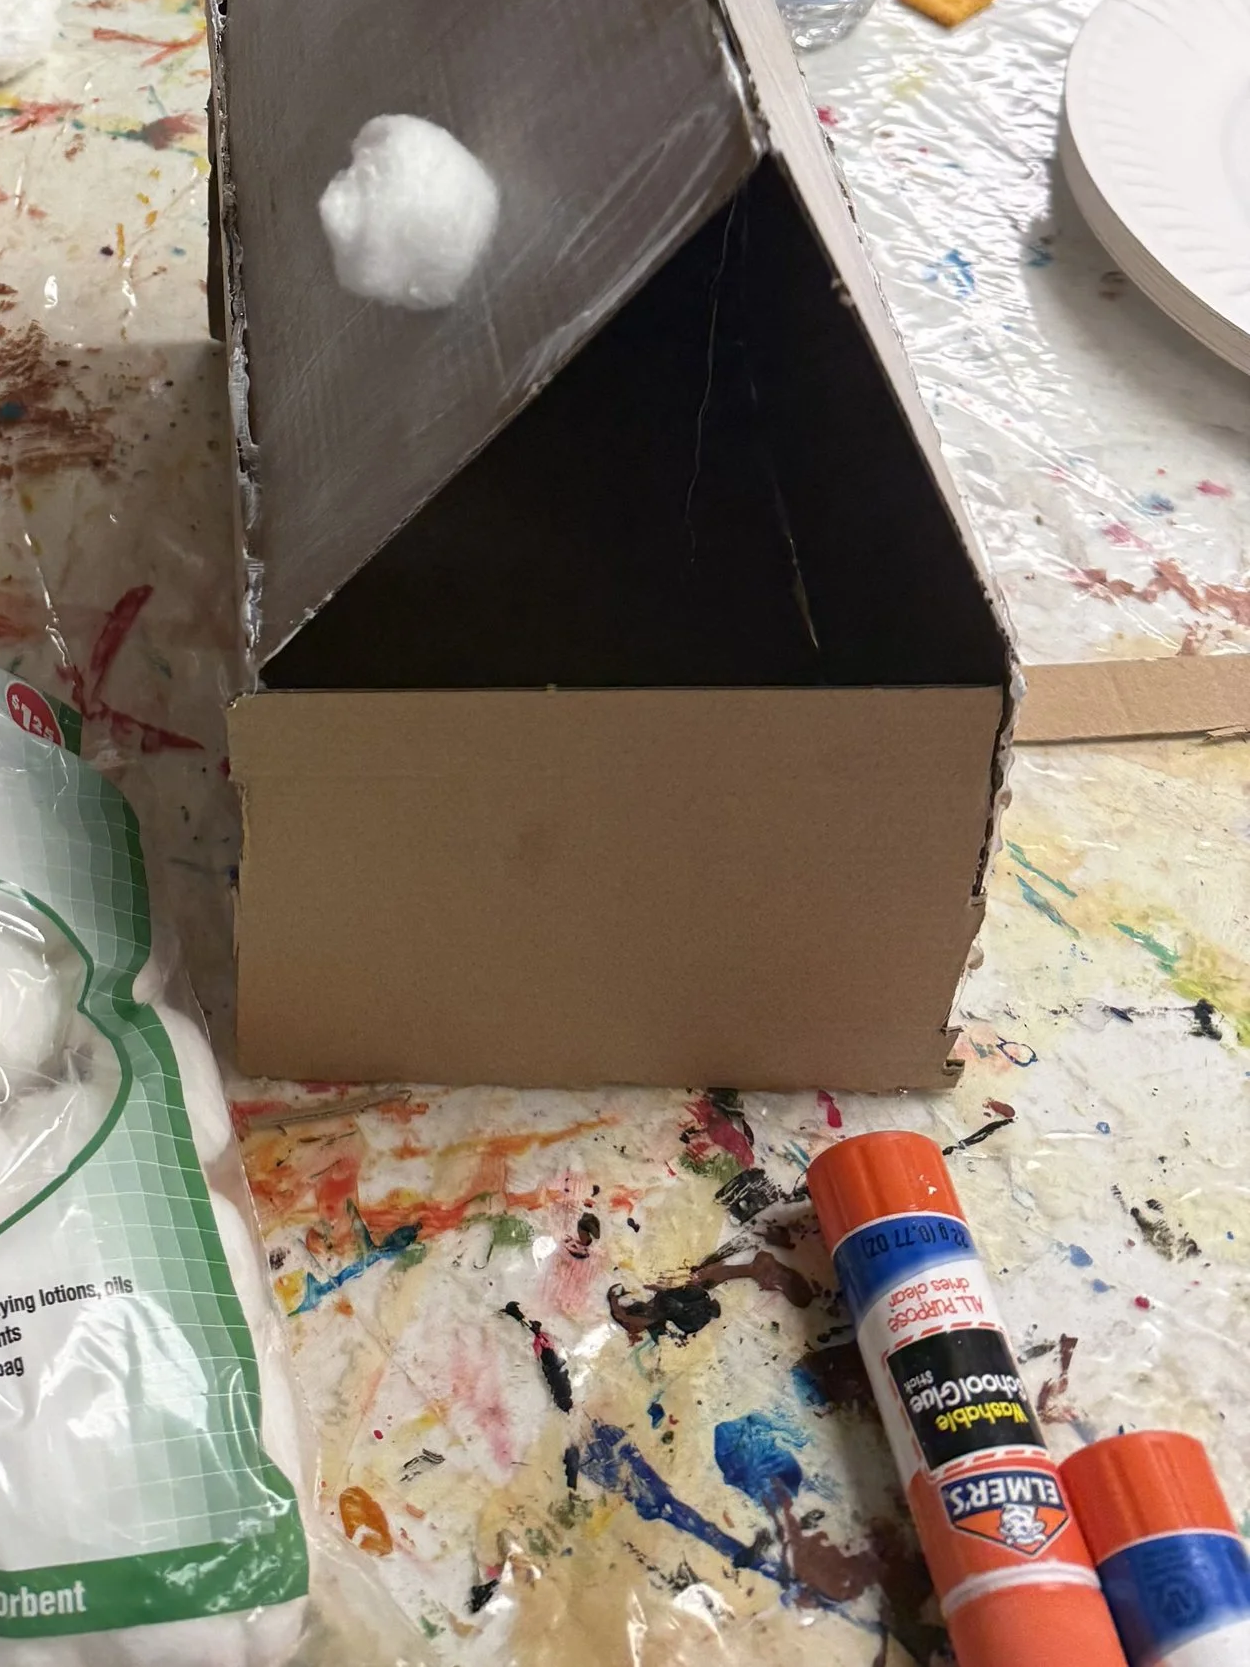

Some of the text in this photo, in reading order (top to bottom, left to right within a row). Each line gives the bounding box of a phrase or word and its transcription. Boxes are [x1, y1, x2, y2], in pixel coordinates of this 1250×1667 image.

[39, 1282, 102, 1308] lotions,
[104, 1276, 134, 1296] oils
[889, 1277, 970, 1308] dries clear
[958, 1295, 984, 1314] ALL
[935, 1402, 1029, 1432] Washable
[951, 1477, 1060, 1516] ELMER'S
